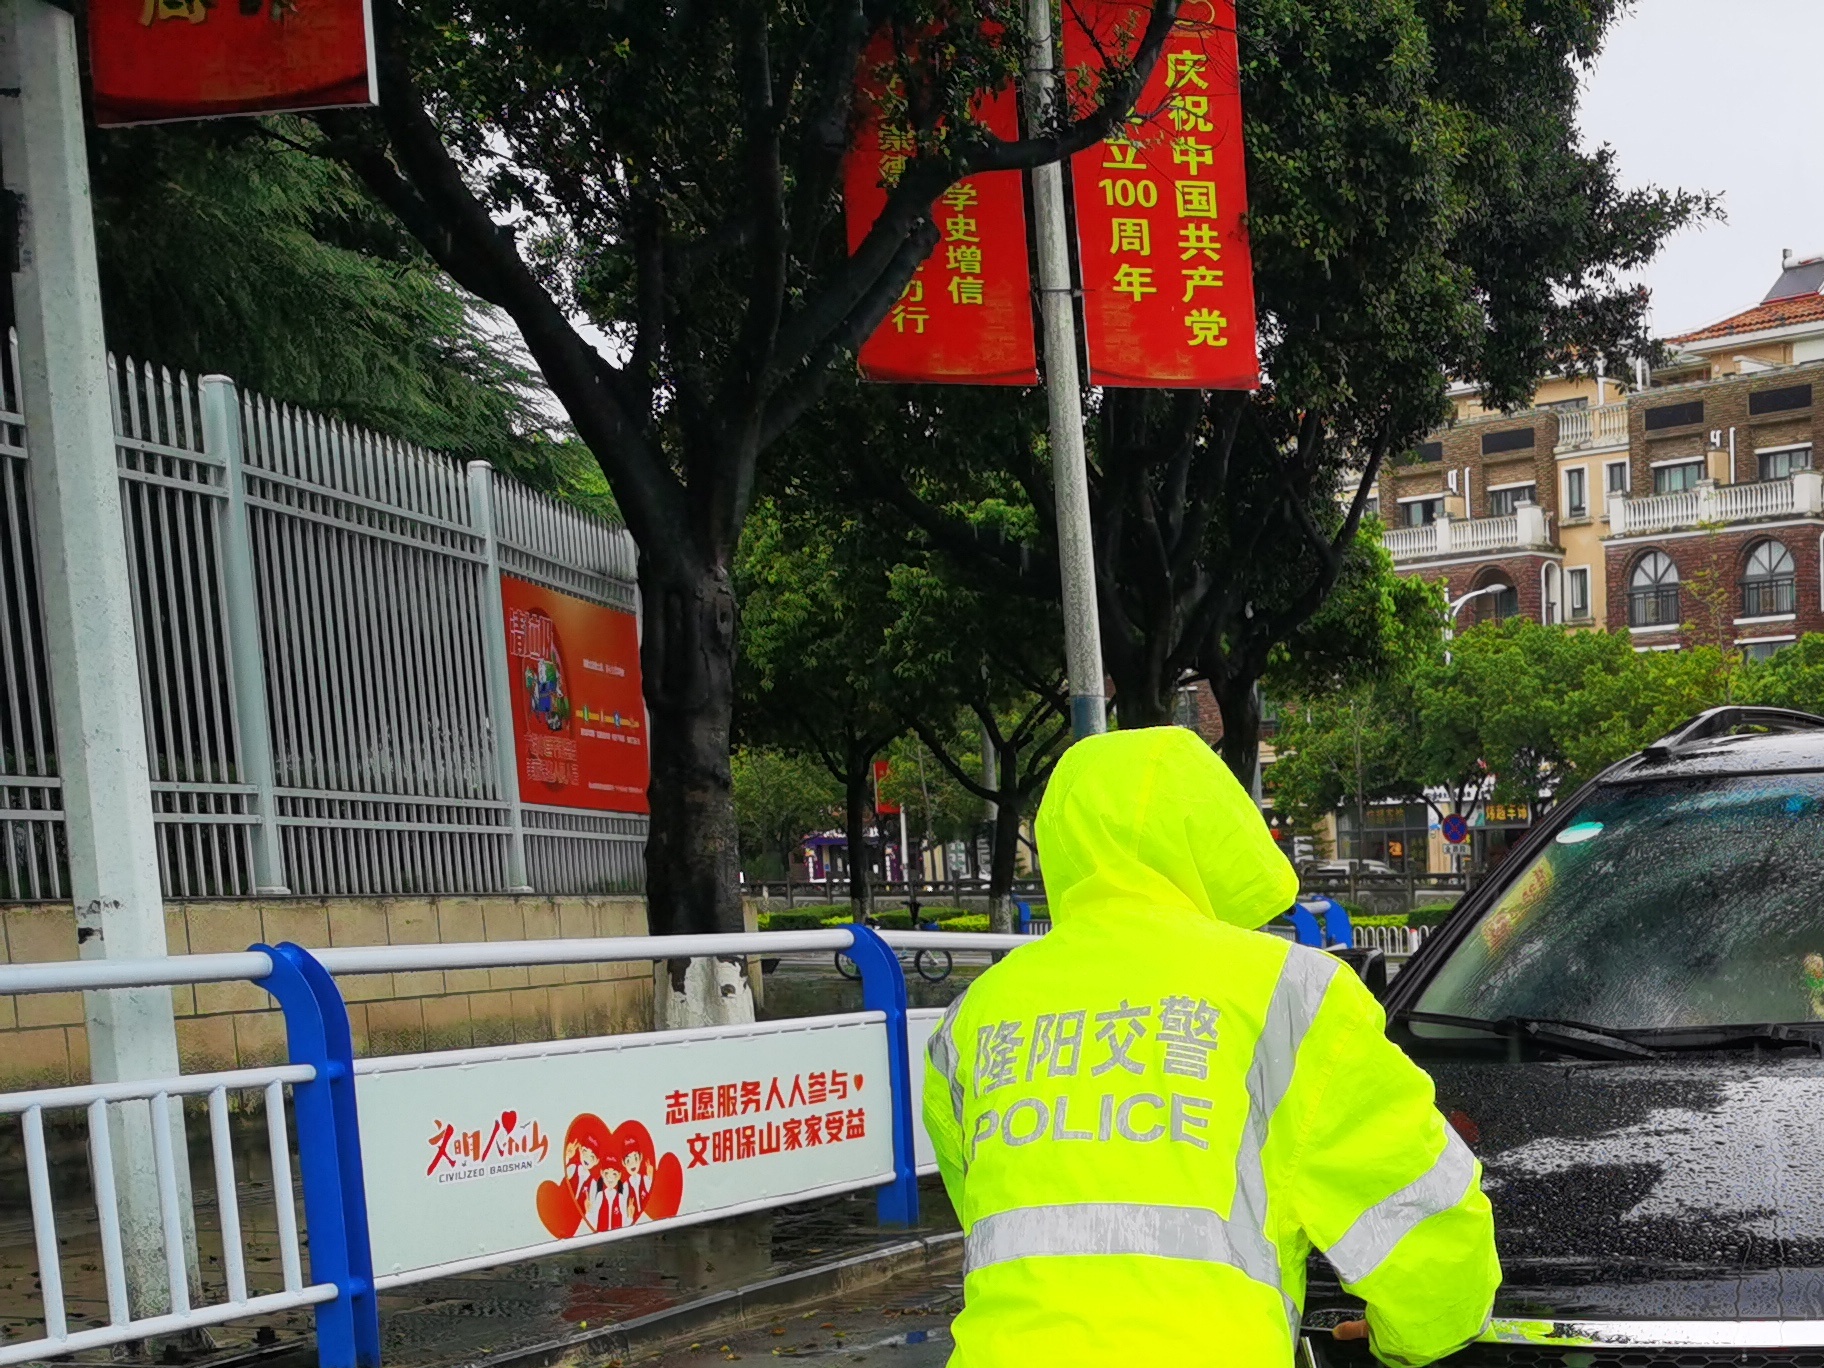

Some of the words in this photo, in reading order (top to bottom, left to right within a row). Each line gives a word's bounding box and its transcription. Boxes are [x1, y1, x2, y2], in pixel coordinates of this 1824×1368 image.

[1099, 106, 1158, 302] 立100周年
[1165, 50, 1228, 347] 庆祝中国共产党
[942, 182, 985, 305] 学史增信
[974, 995, 1221, 1099] 隆阳交警
[665, 1069, 848, 1125] 志愿服务人人参与
[687, 1108, 866, 1169] 文明保山家家受益
[971, 1093, 1213, 1162] POLICE
[439, 1167, 485, 1183] CIVILIZED
[490, 1160, 533, 1175] BAOSHAN
